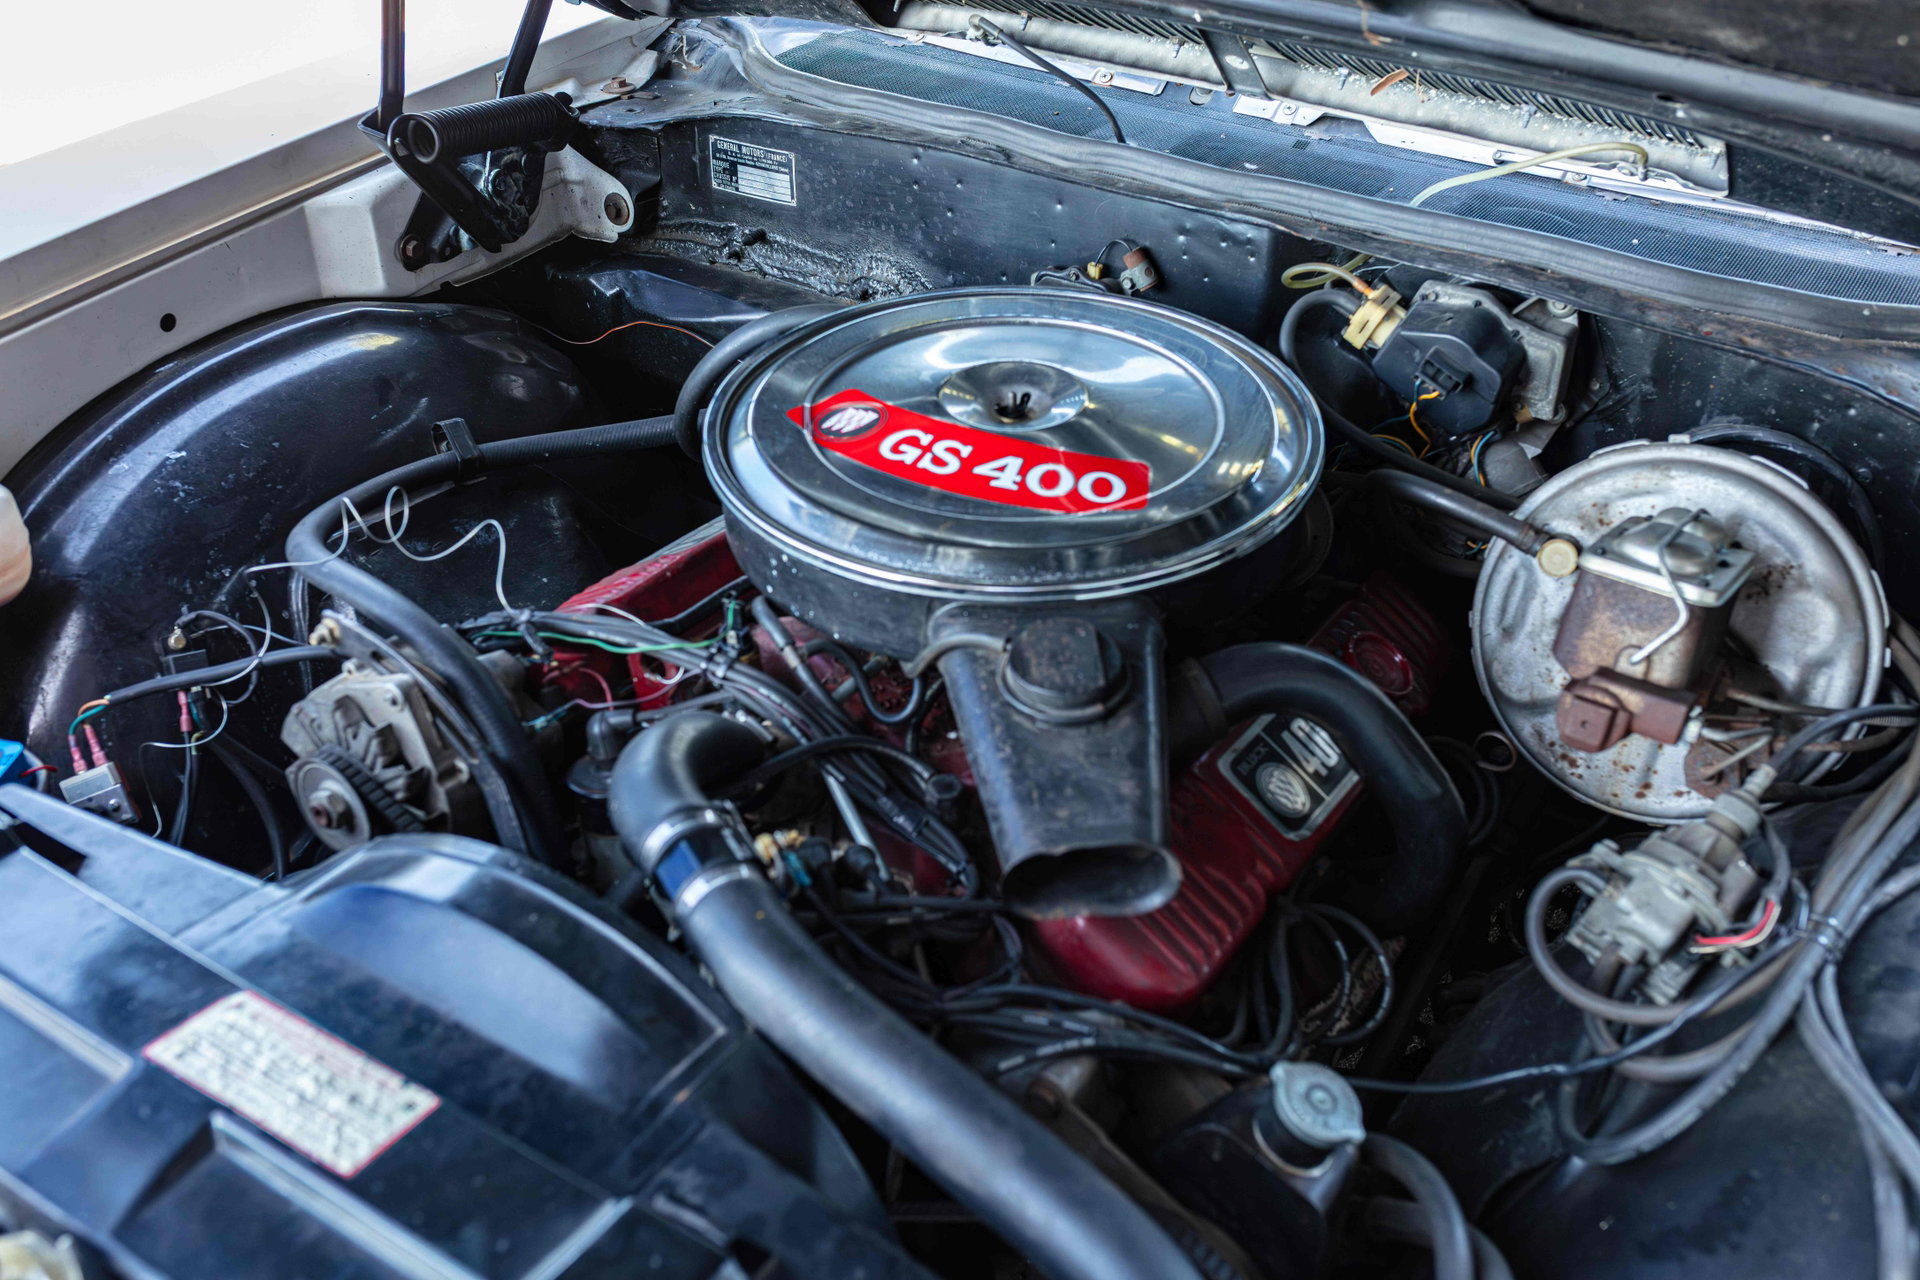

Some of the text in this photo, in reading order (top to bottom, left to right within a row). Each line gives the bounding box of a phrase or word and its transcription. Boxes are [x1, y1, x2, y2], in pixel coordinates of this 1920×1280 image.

[717, 140, 739, 153] GENERAL
[741, 146, 764, 158] MOTORS
[879, 428, 1127, 504] GS 400
